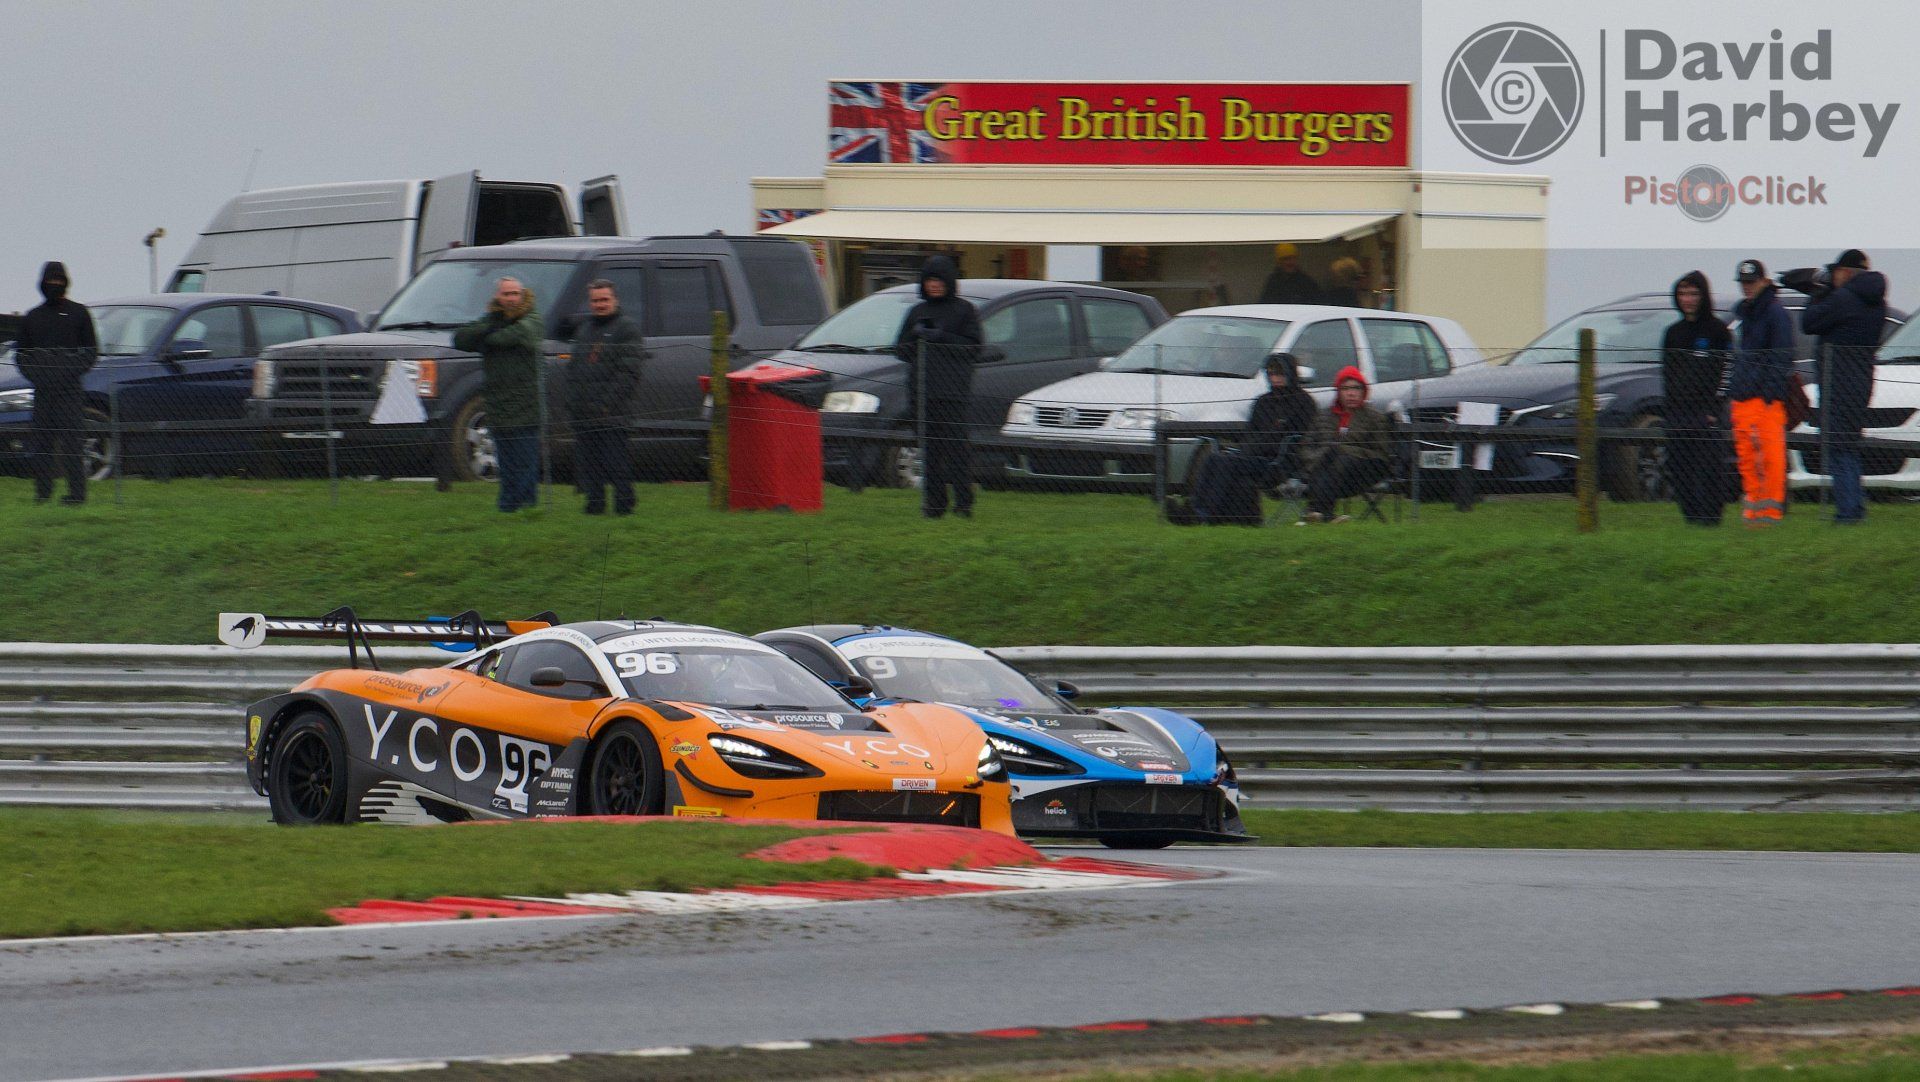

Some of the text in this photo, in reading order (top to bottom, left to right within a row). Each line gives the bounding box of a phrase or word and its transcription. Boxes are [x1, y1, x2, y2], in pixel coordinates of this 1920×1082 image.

[924, 96, 1393, 156] Great British Burgers
[615, 652, 677, 678] 96
[865, 656, 898, 679] 9
[364, 704, 487, 782] Y.CO
[822, 740, 931, 758] Y.CO
[501, 742, 547, 794] 96
[901, 780, 929, 789] DRIVEN
[1044, 806, 1067, 815] helios
